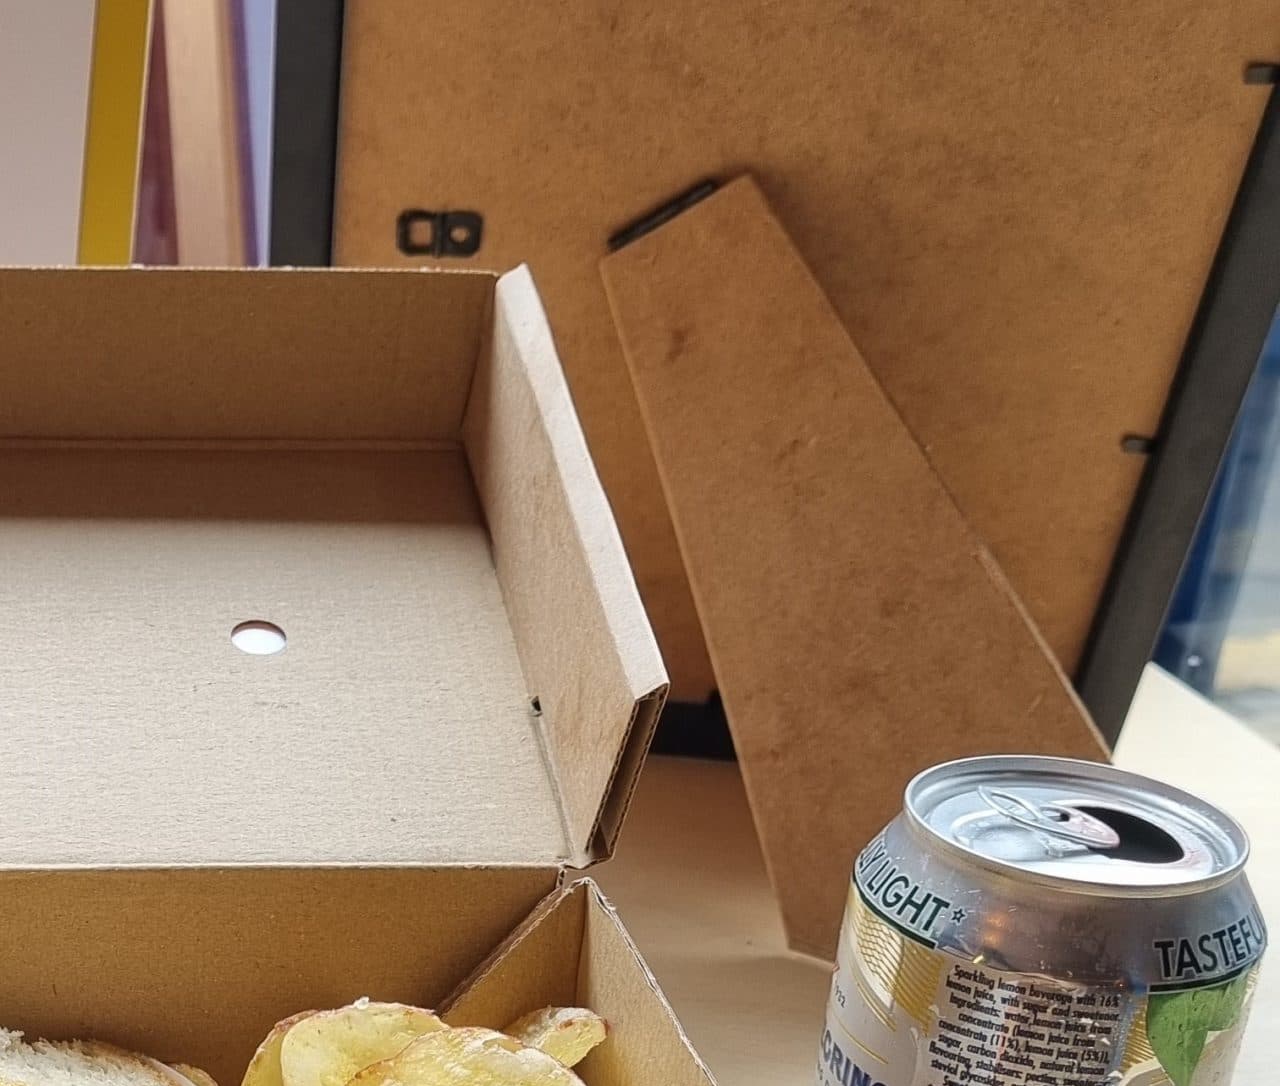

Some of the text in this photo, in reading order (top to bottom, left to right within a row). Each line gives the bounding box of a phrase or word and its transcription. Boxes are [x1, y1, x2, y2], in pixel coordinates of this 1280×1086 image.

[866, 860, 951, 931] LIGHT
[946, 976, 972, 995] lemon
[973, 987, 996, 1005] juice,
[1001, 995, 1020, 1008] with
[1023, 1001, 1049, 1015] sugar
[1051, 1003, 1070, 1017] and
[954, 965, 1120, 1008] Sparkling lemon beverage with 16%
[958, 1012, 1095, 1047] concentrate (lemon juice from
[938, 1033, 1105, 1076] sugar, carbon dioxide, natural lemon
